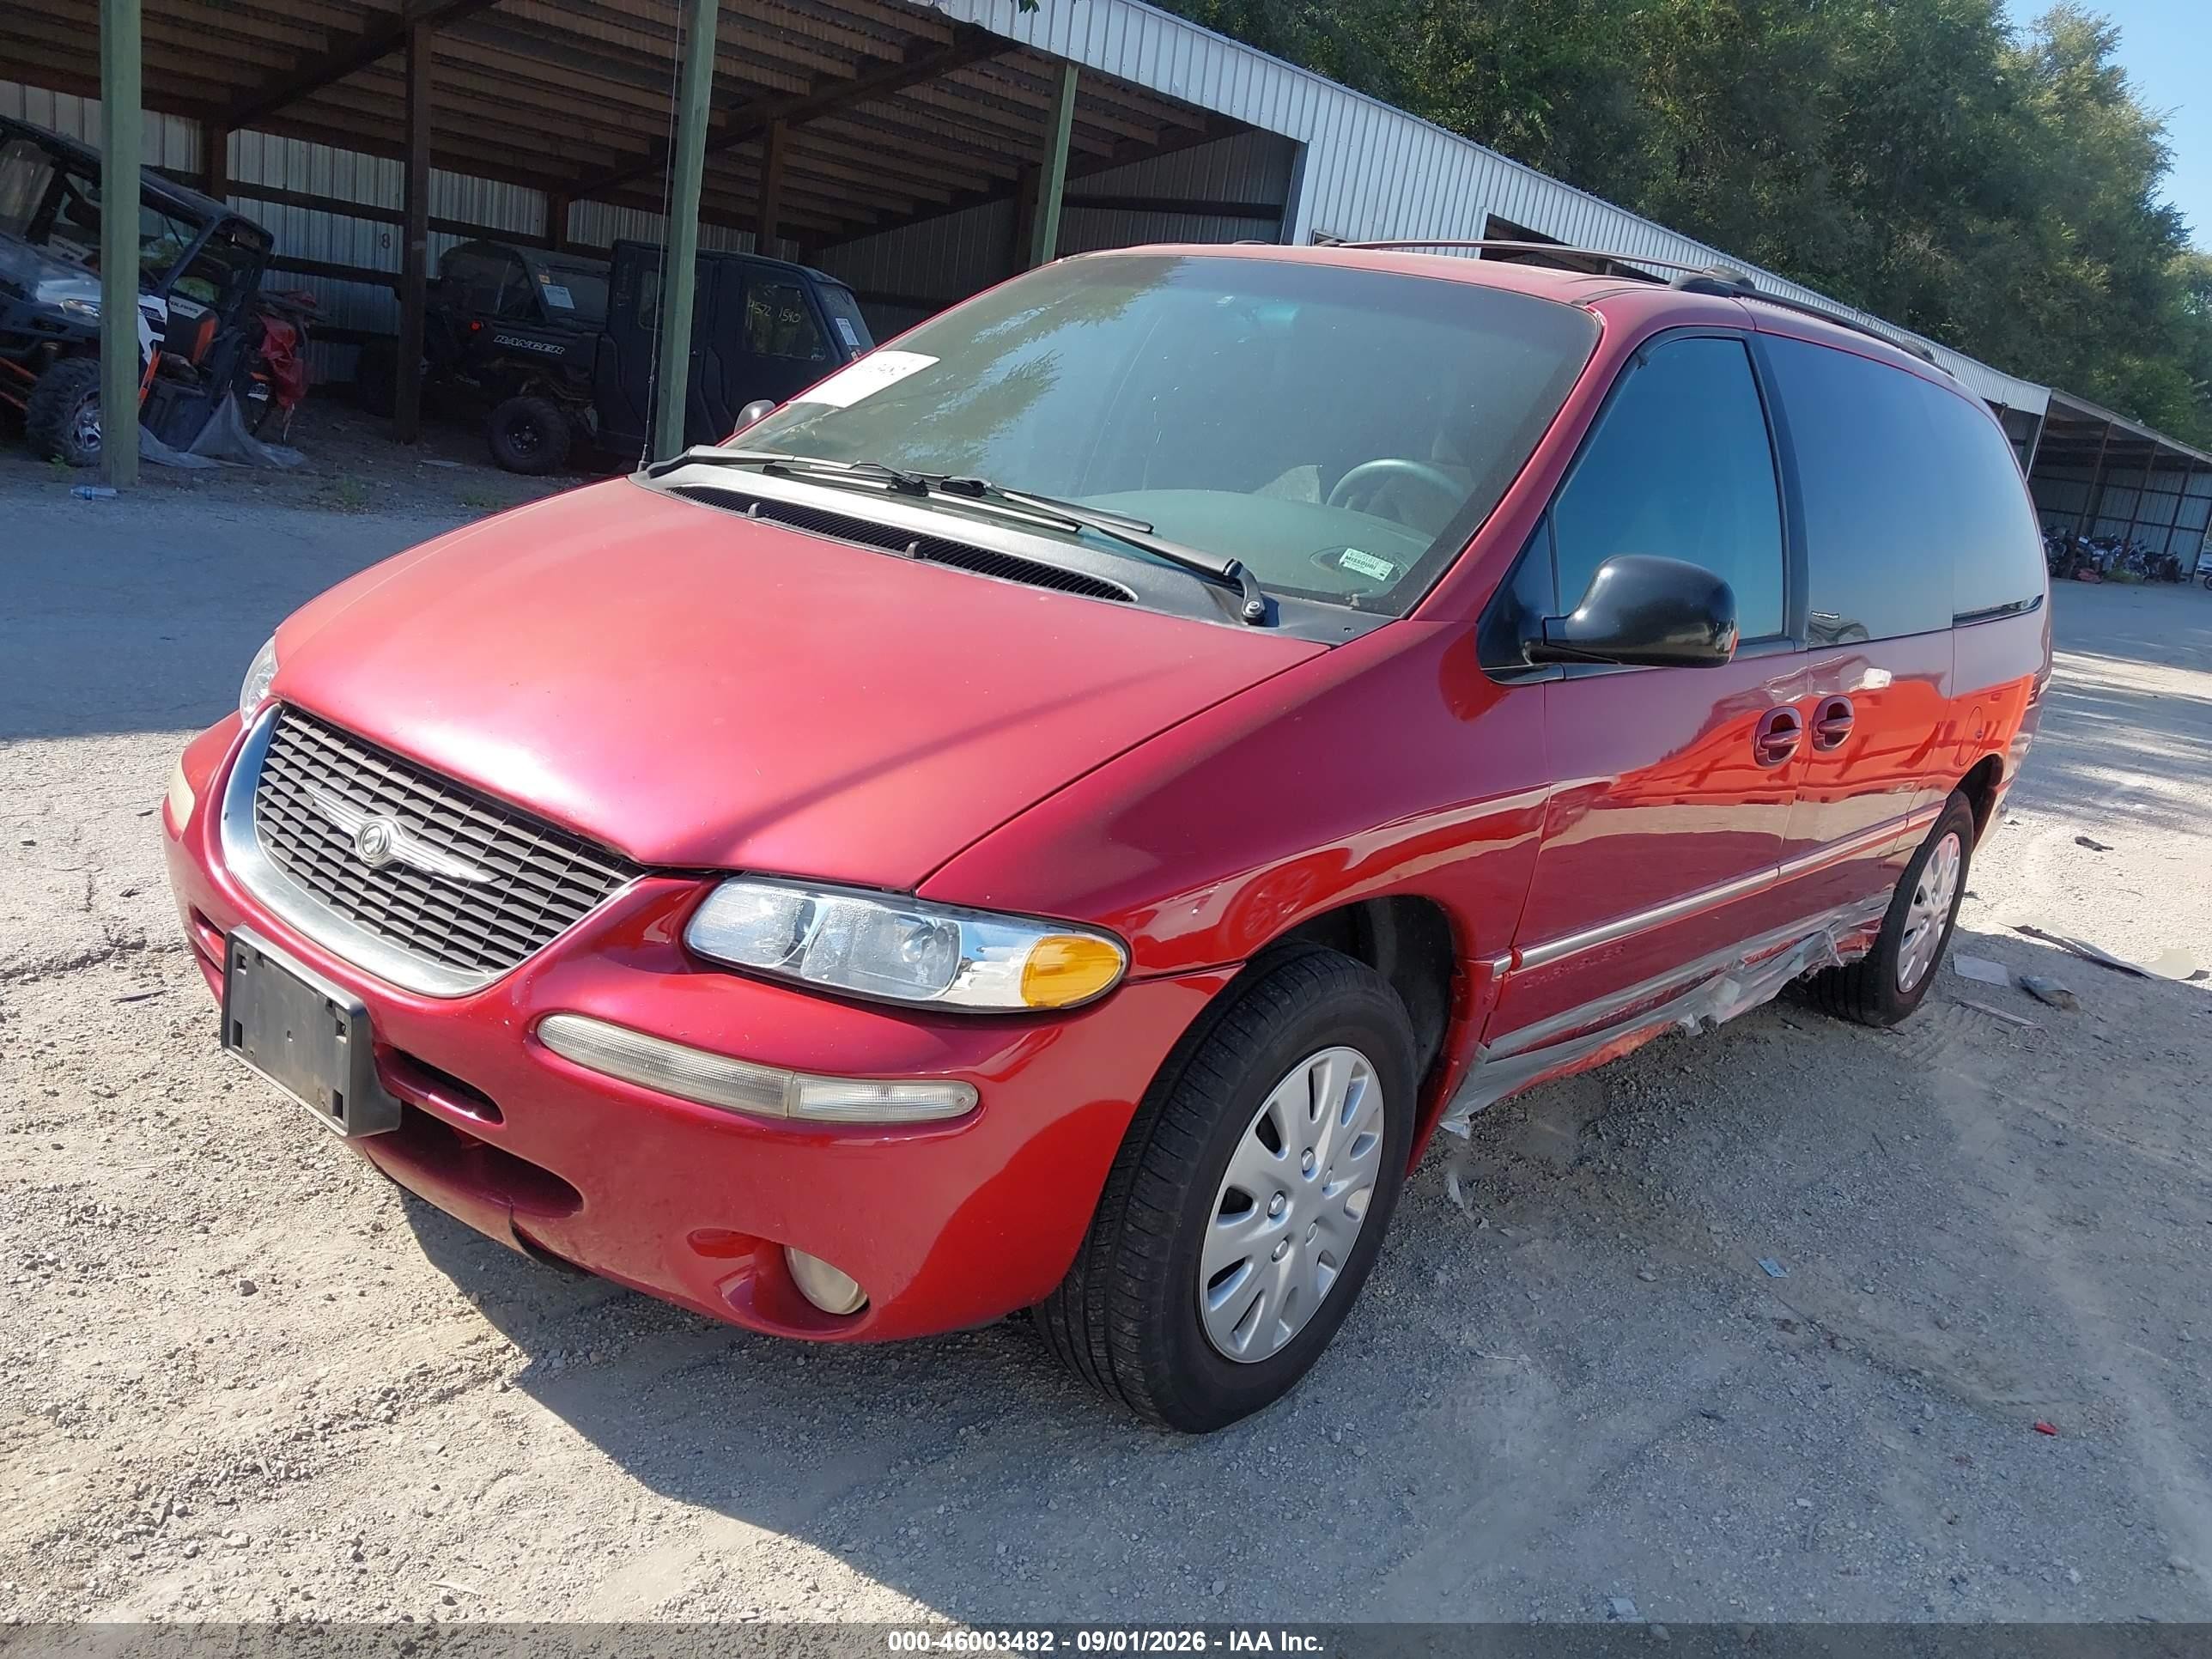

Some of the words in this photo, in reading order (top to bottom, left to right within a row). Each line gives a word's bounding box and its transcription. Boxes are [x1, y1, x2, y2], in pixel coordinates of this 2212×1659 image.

[381, 233, 391, 249] 8
[493, 335, 566, 356] RANGER
[1346, 556, 1377, 571] MISSOURI
